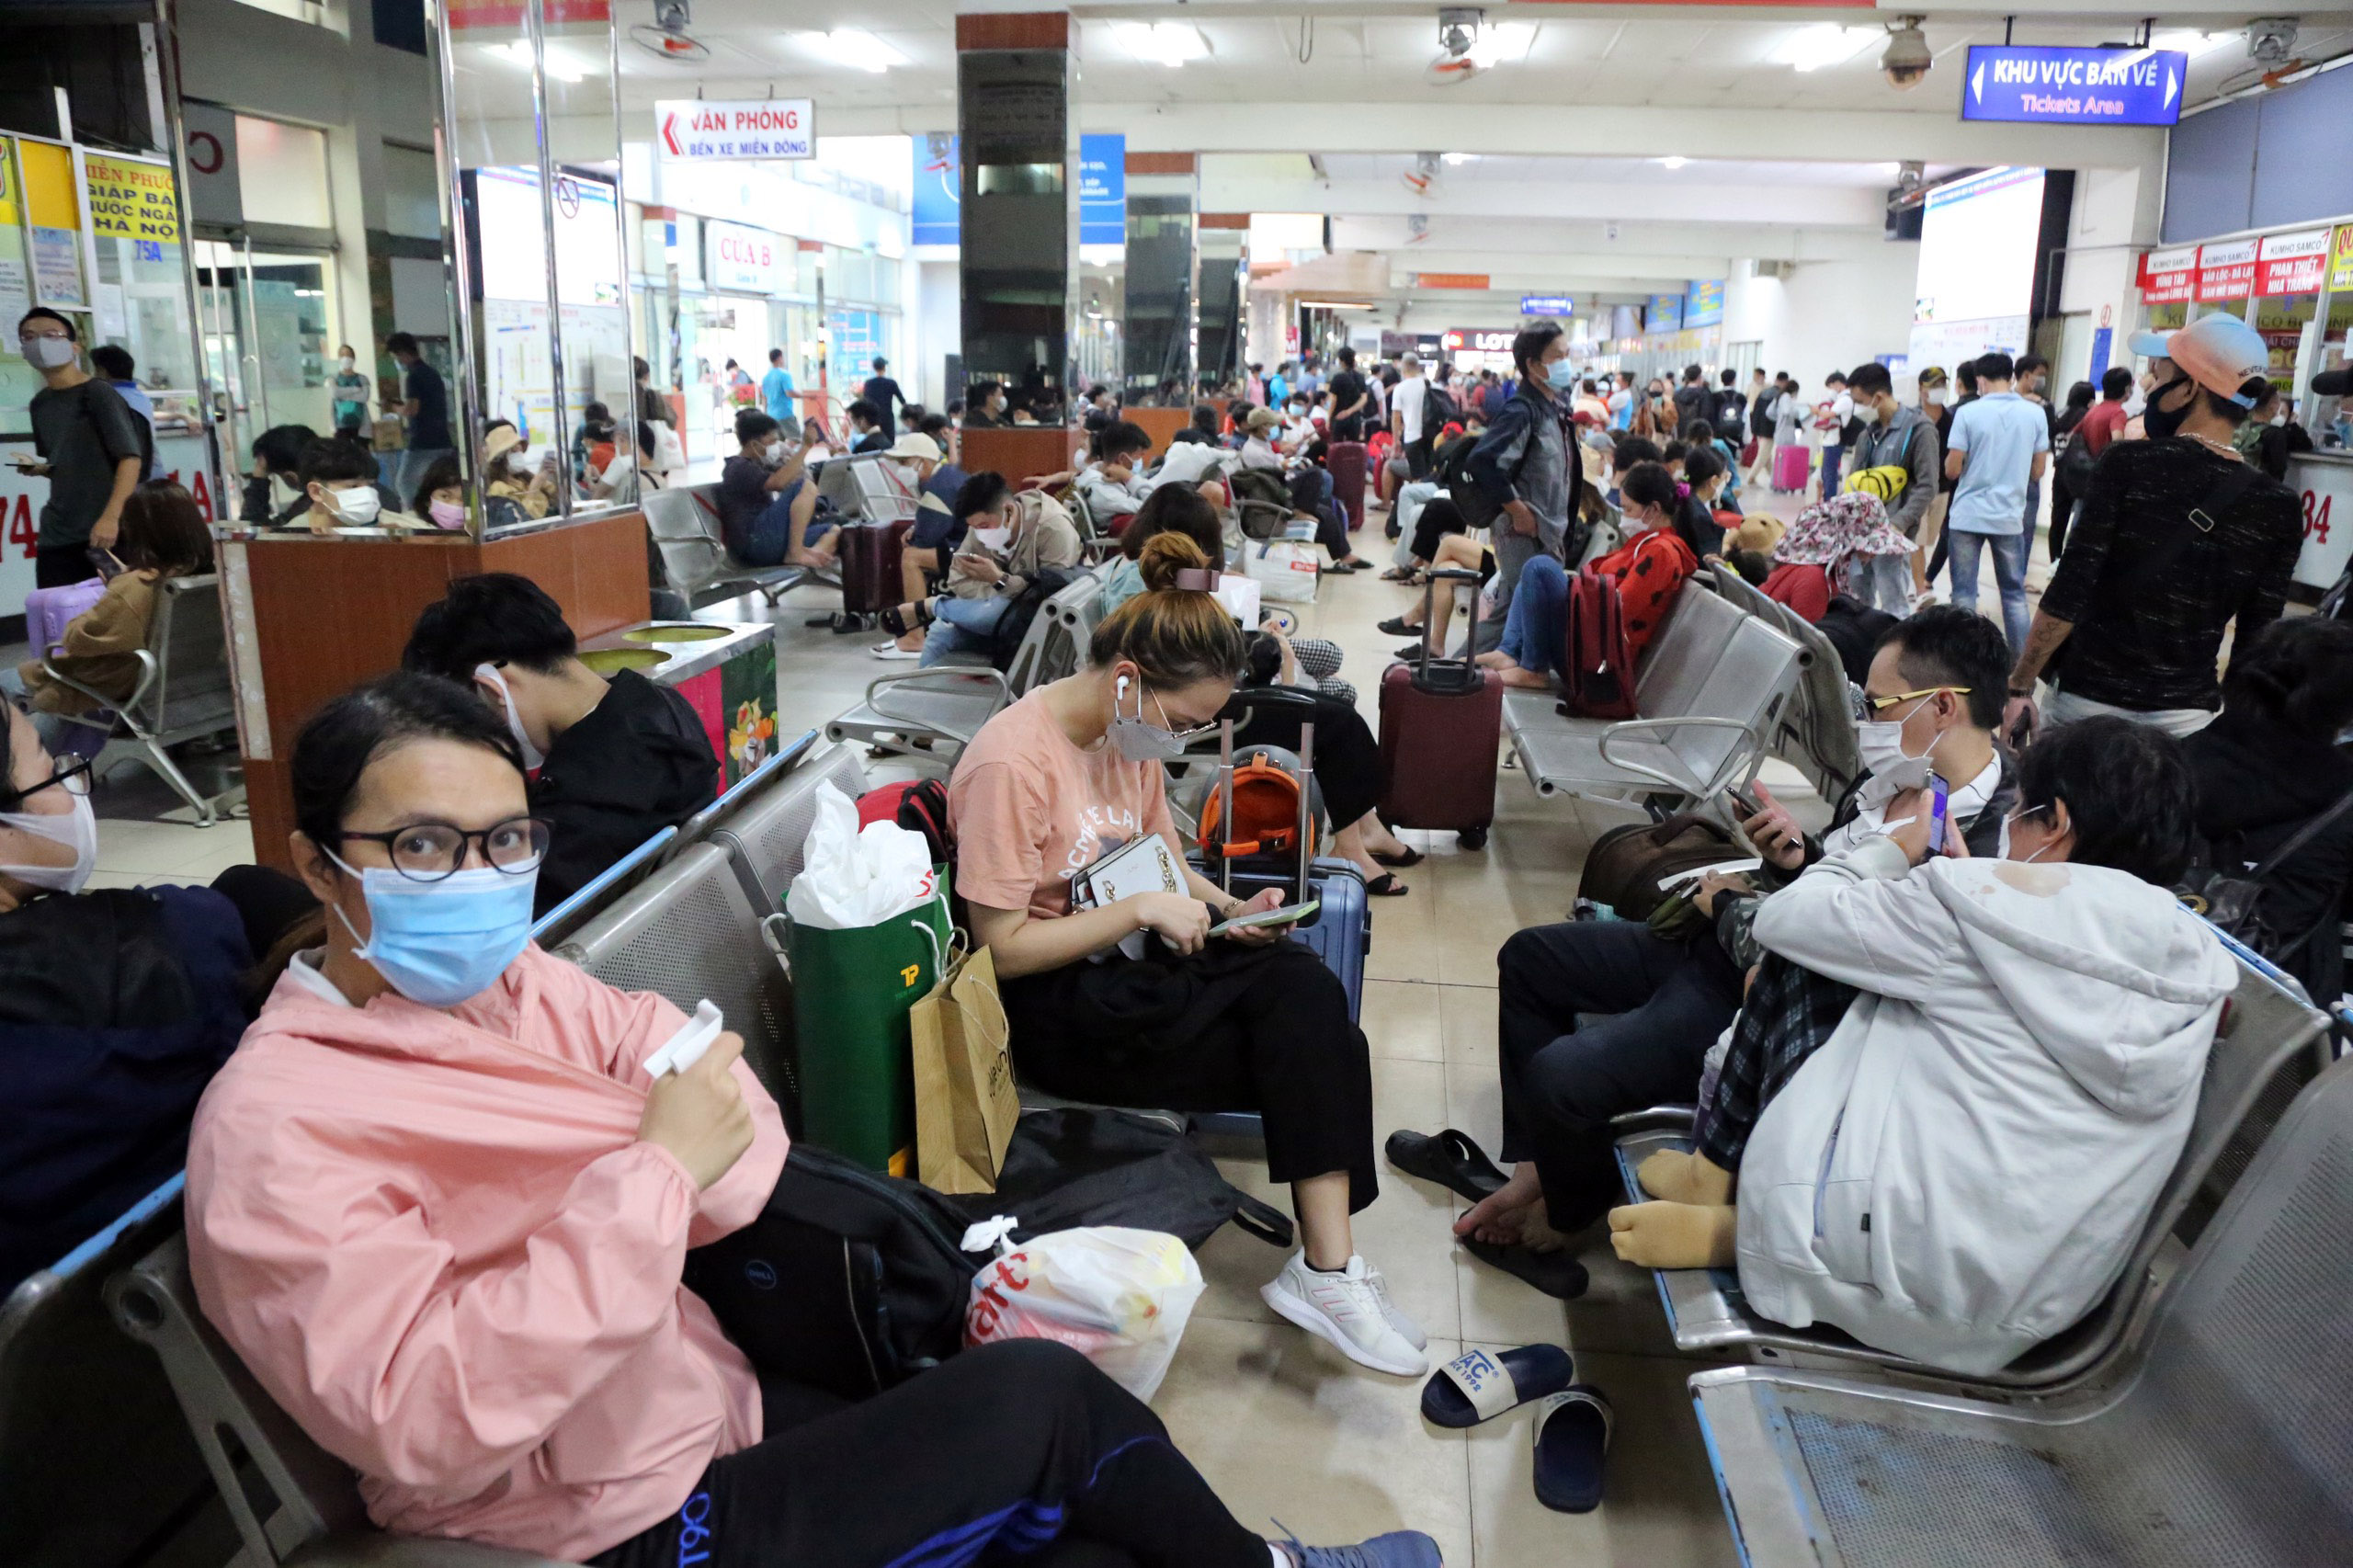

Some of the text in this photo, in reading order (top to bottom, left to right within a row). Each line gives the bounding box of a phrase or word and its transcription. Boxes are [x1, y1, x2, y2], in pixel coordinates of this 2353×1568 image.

[1994, 59, 2037, 85] KHU
[2041, 58, 2084, 90] VỰC
[2132, 60, 2158, 86] VÉ
[2020, 93, 2124, 115] Tickets Area
[691, 106, 798, 131] VĂN PHÒNG
[689, 139, 713, 155] BẾN
[719, 142, 734, 155] XE
[739, 137, 768, 155] MIỀN
[94, 217, 131, 232] HÀ
[2269, 240, 2322, 256] KUMHO SAMCO
[2269, 260, 2294, 278] PHAN
[2267, 278, 2285, 294] NHA
[2301, 489, 2333, 544] 34
